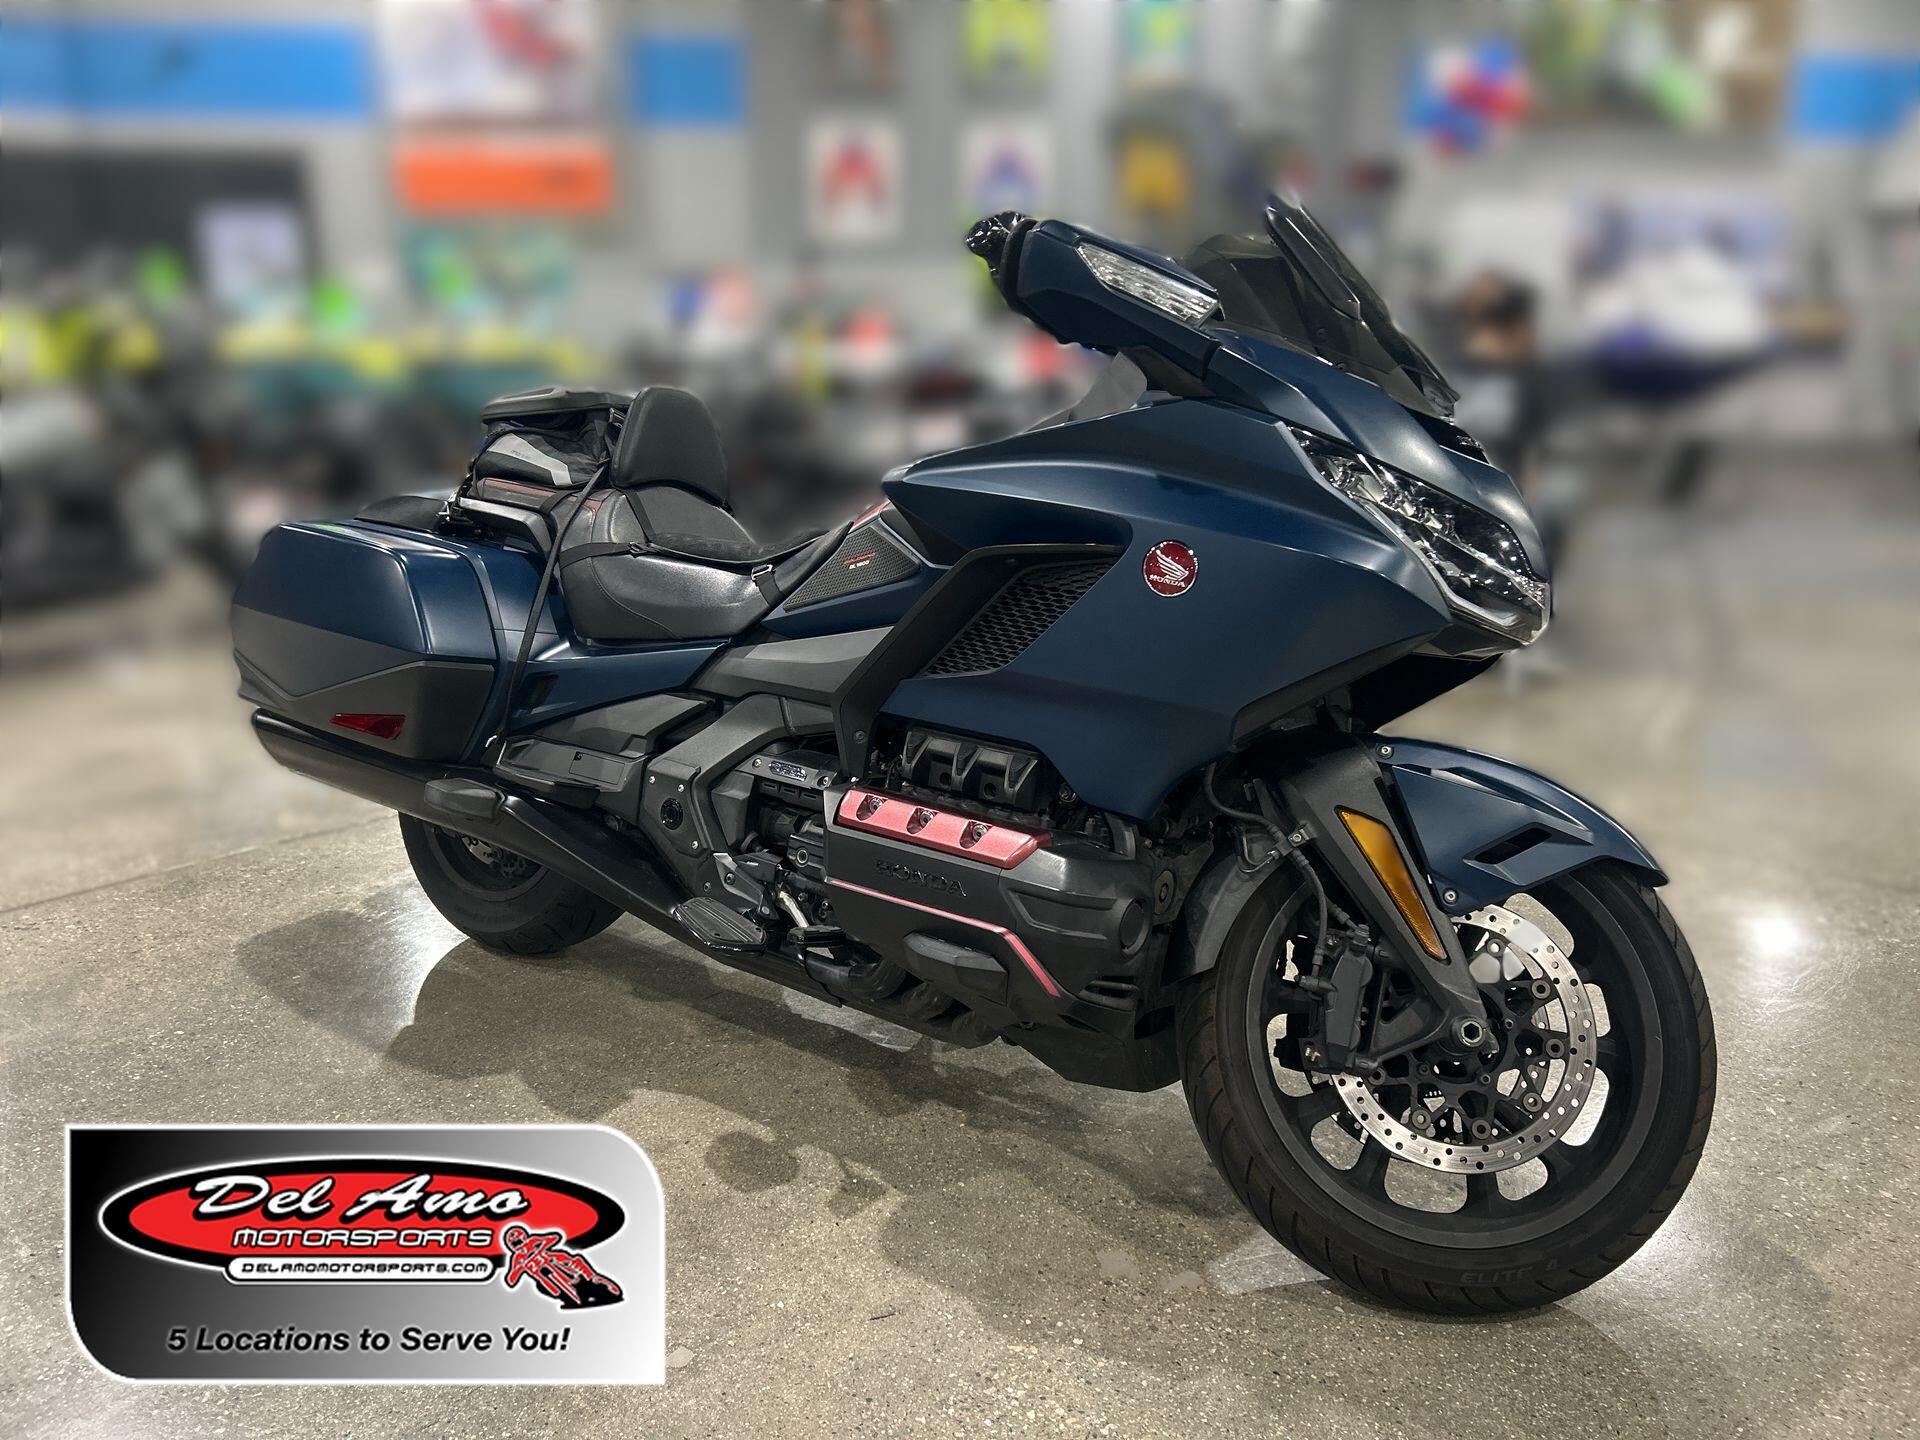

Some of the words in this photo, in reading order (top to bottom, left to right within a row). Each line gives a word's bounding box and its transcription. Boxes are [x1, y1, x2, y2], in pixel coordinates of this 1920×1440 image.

[1148, 573, 1186, 588] HONDA
[874, 857, 968, 898] HONDA
[1459, 1265, 1534, 1284] ELITE
